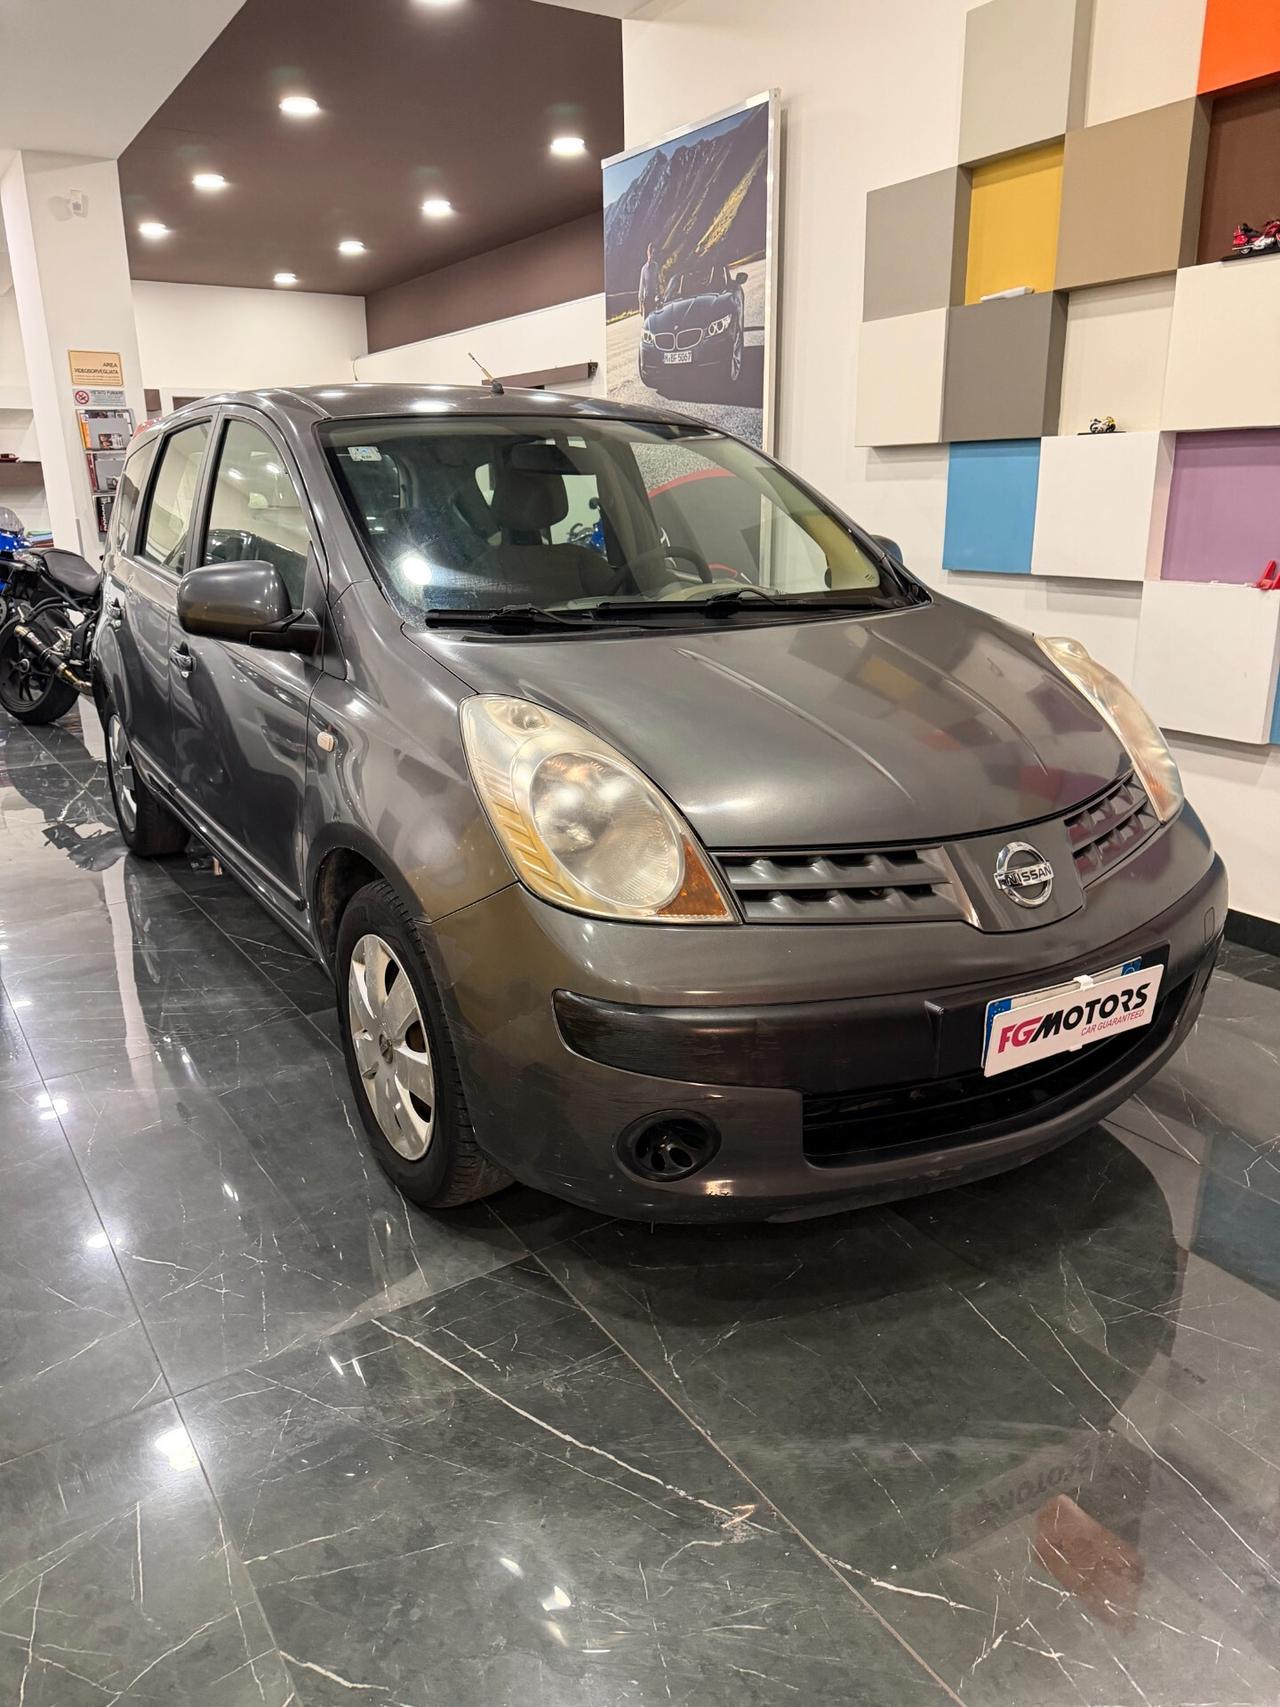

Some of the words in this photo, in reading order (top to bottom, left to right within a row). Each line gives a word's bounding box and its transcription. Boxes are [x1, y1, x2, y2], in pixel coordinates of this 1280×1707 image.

[1005, 865, 1052, 886] NISSAN
[1081, 1025, 1097, 1036] CAR
[1097, 1009, 1145, 1031] GUARANTEED
